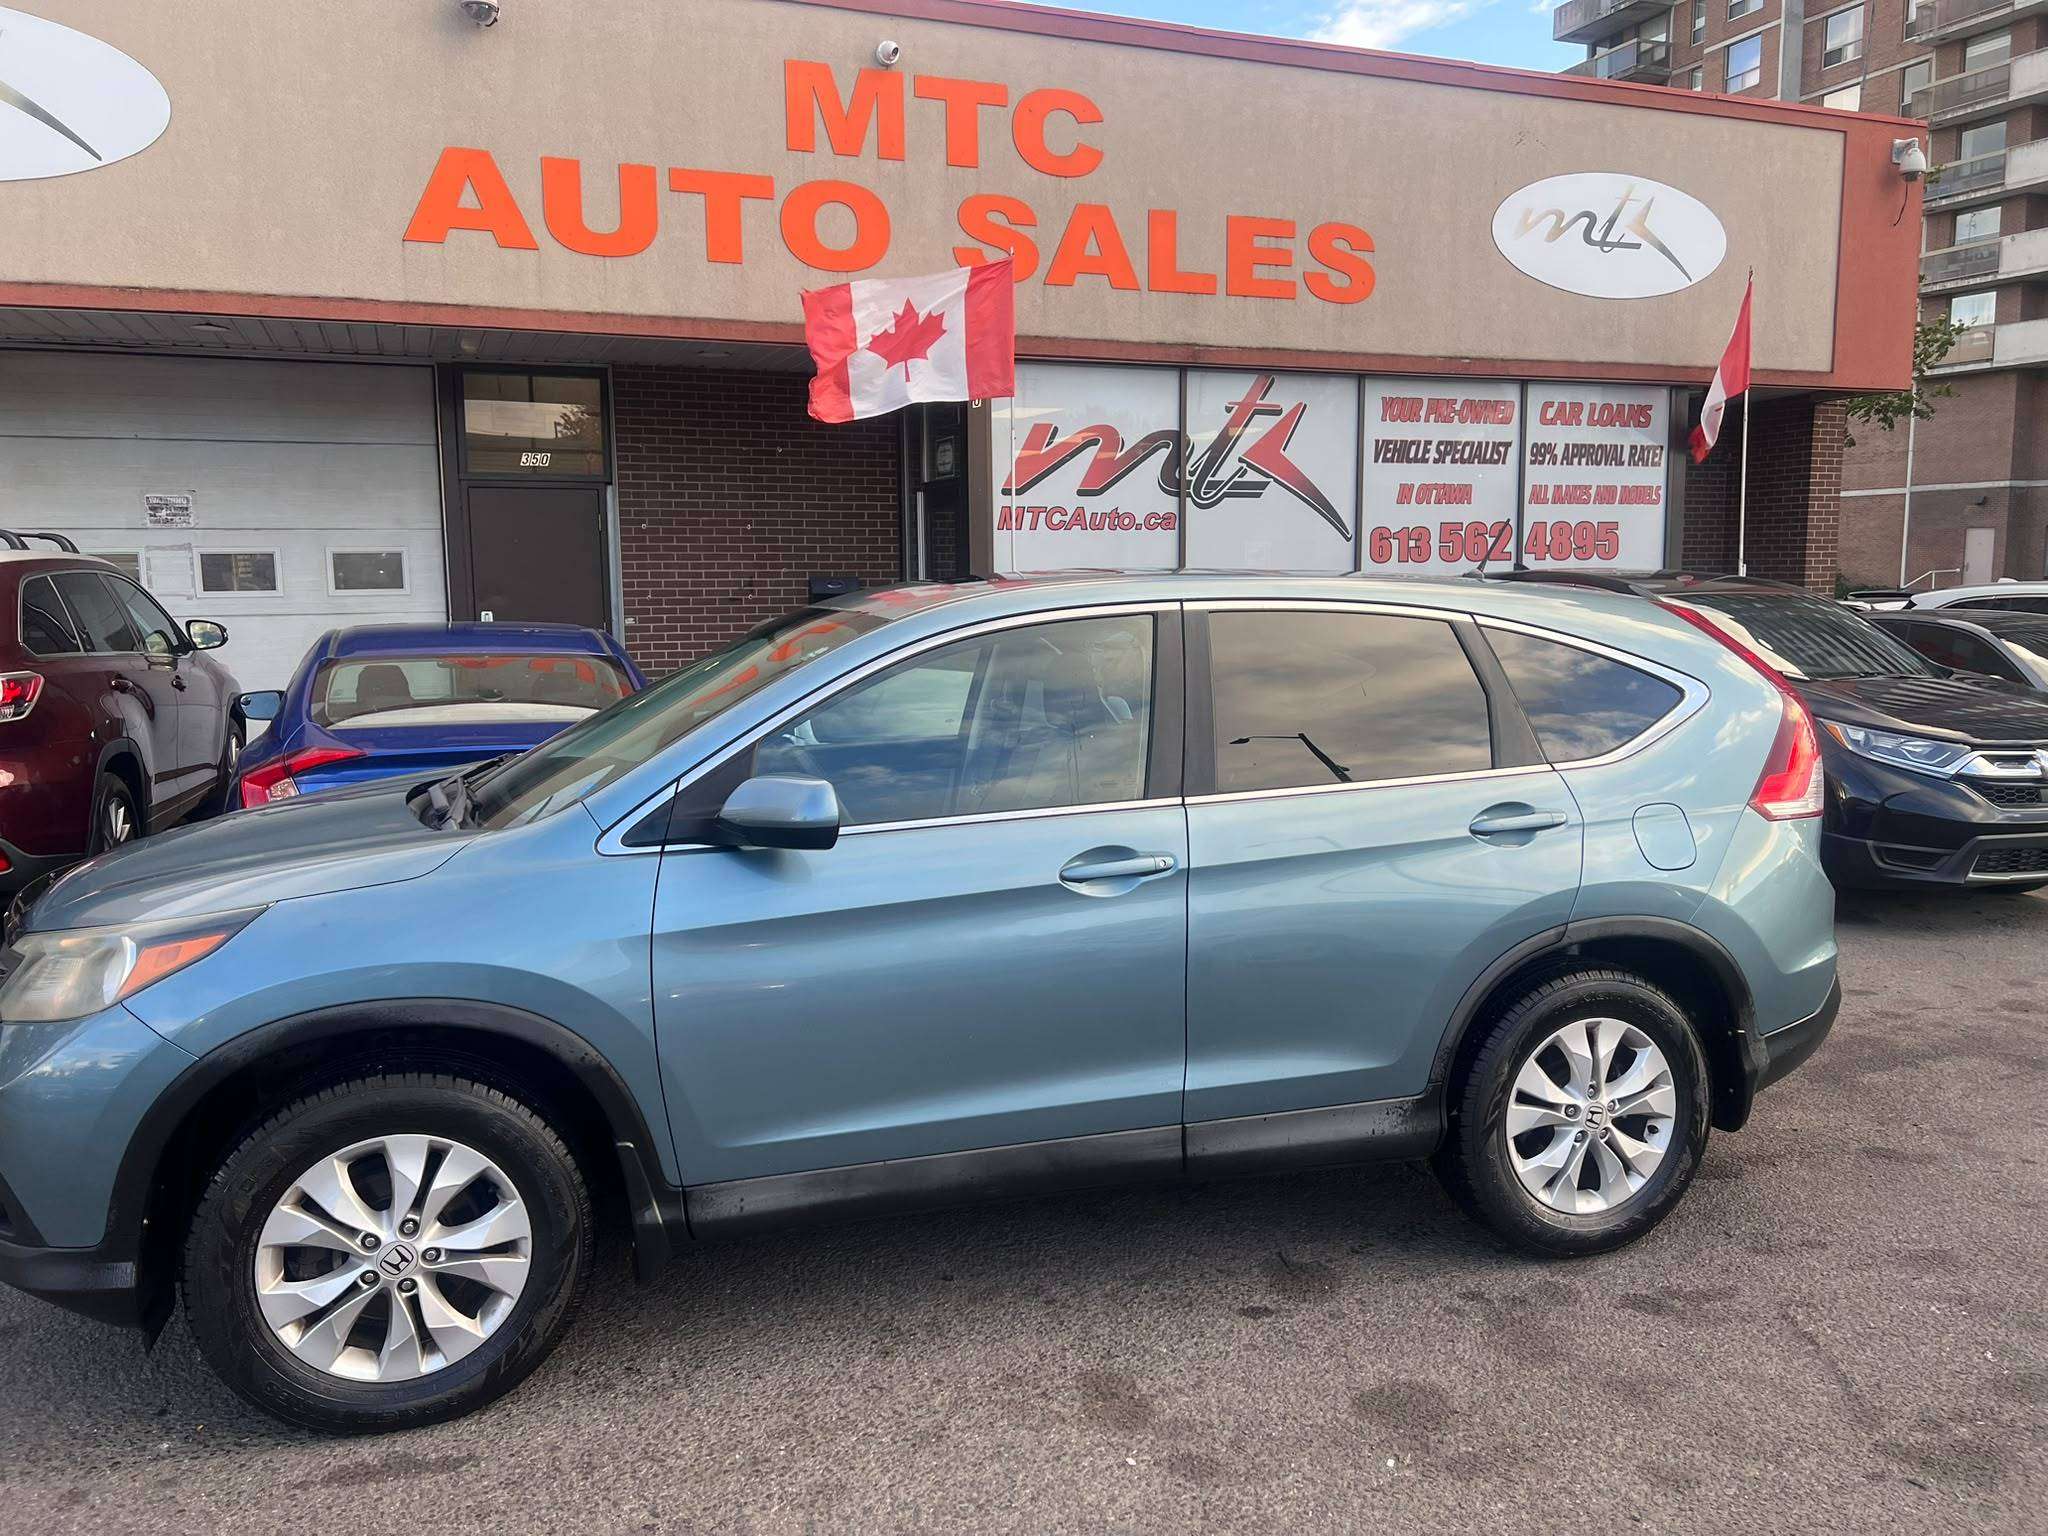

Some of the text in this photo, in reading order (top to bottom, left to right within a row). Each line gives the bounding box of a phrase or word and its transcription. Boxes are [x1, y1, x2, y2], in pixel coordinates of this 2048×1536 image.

[786, 59, 1104, 178] MTC
[404, 147, 1377, 304] AUTO SALES
[1381, 396, 1515, 425] YOUR PRE-OWNED
[1539, 401, 1653, 428] CAR LOANS
[521, 453, 550, 466] 350
[1373, 439, 1512, 465] VEHICLE SPECIALIST
[1529, 442, 1664, 467] 99% APPROVAL RATE!
[1396, 483, 1473, 504] IN OTTAWA
[1528, 484, 1662, 505] ALL MAKES AND MODELS
[997, 505, 1177, 531] MTCAuto.ca
[1369, 520, 1620, 564] 613 562 4895
